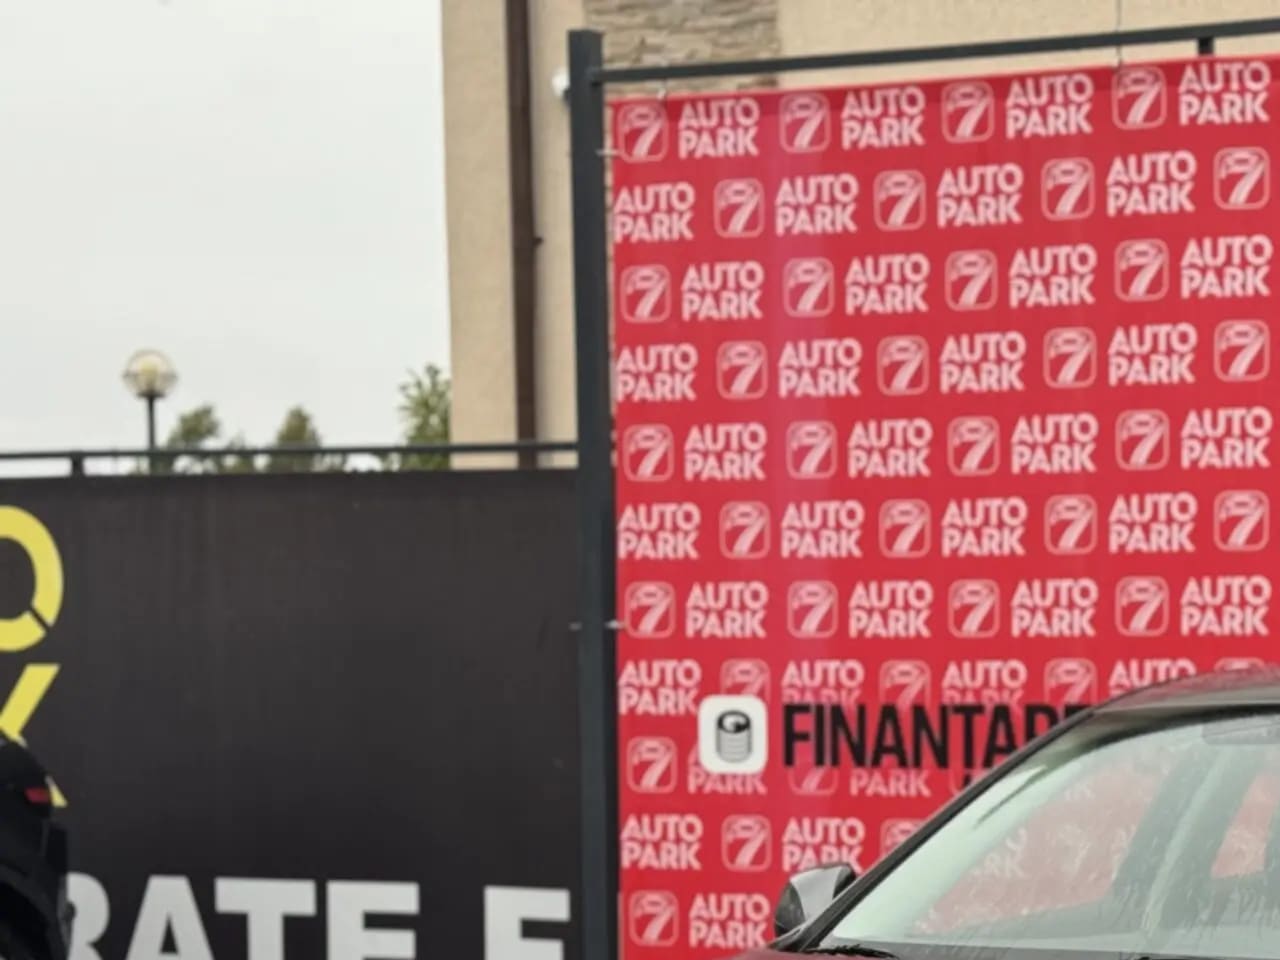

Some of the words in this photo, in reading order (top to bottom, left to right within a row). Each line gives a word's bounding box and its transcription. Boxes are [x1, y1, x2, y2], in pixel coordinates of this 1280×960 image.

[1006, 75, 1092, 108] AUTO
[1179, 61, 1270, 93] AUTO
[679, 99, 758, 130] AUTO
[842, 87, 924, 119] AUTO
[1180, 93, 1268, 125] PARK
[842, 115, 923, 149] PARK
[1007, 103, 1092, 138] PARK
[679, 126, 758, 158] PARK
[937, 163, 1023, 197] AUTO
[1107, 151, 1196, 185] AUTO
[613, 182, 694, 214] AUTO
[775, 174, 858, 206] AUTO
[1107, 181, 1194, 216] PARK
[776, 202, 856, 235] PARK
[938, 193, 1021, 227] PARK
[613, 212, 693, 243] PARK
[1010, 244, 1096, 278] AUTO
[1181, 235, 1272, 268] AUTO
[682, 261, 764, 292] AUTO
[845, 253, 930, 285] AUTO
[1181, 265, 1269, 298] PARK
[682, 290, 762, 320] PARK
[846, 282, 928, 314] PARK
[1010, 274, 1094, 307] PARK
[779, 338, 862, 369] AUTO
[940, 331, 1026, 363] AUTO
[1109, 323, 1197, 356] AUTO
[616, 344, 697, 374] AUTO
[1109, 352, 1194, 386] PARK
[616, 371, 695, 401] PARK
[779, 367, 859, 397] PARK
[941, 361, 1023, 393] PARK
[685, 423, 766, 452] AUTO
[848, 418, 932, 449] AUTO
[1012, 413, 1098, 445] AUTO
[1181, 407, 1272, 439] AUTO
[685, 450, 764, 480] PARK
[849, 447, 930, 477] PARK
[1012, 442, 1095, 473] PARK
[1181, 437, 1269, 468] PARK
[618, 503, 700, 532] AUTO
[781, 500, 864, 530] AUTO
[942, 497, 1027, 527] AUTO
[1109, 492, 1197, 524] AUTO
[618, 530, 697, 558] PARK
[781, 528, 861, 558] PARK
[942, 526, 1024, 556] PARK
[1109, 522, 1194, 552] PARK
[686, 581, 768, 609] AUTO
[849, 580, 933, 610] AUTO
[1012, 578, 1098, 607] AUTO
[1181, 576, 1271, 606] AUTO
[686, 609, 765, 637] PARK
[849, 608, 930, 637] PARK
[1012, 607, 1094, 637] PARK
[1181, 605, 1268, 635] PARK
[618, 659, 702, 689] AUTO
[781, 659, 865, 689] AUTO
[941, 658, 1028, 689] AUTO
[618, 687, 699, 716] PARK
[850, 770, 931, 798] PARK
[621, 814, 703, 842] AUTO
[782, 817, 866, 845] AUTO
[621, 840, 700, 869] PARK
[690, 894, 770, 921] AUTO
[690, 920, 766, 950] PARK
